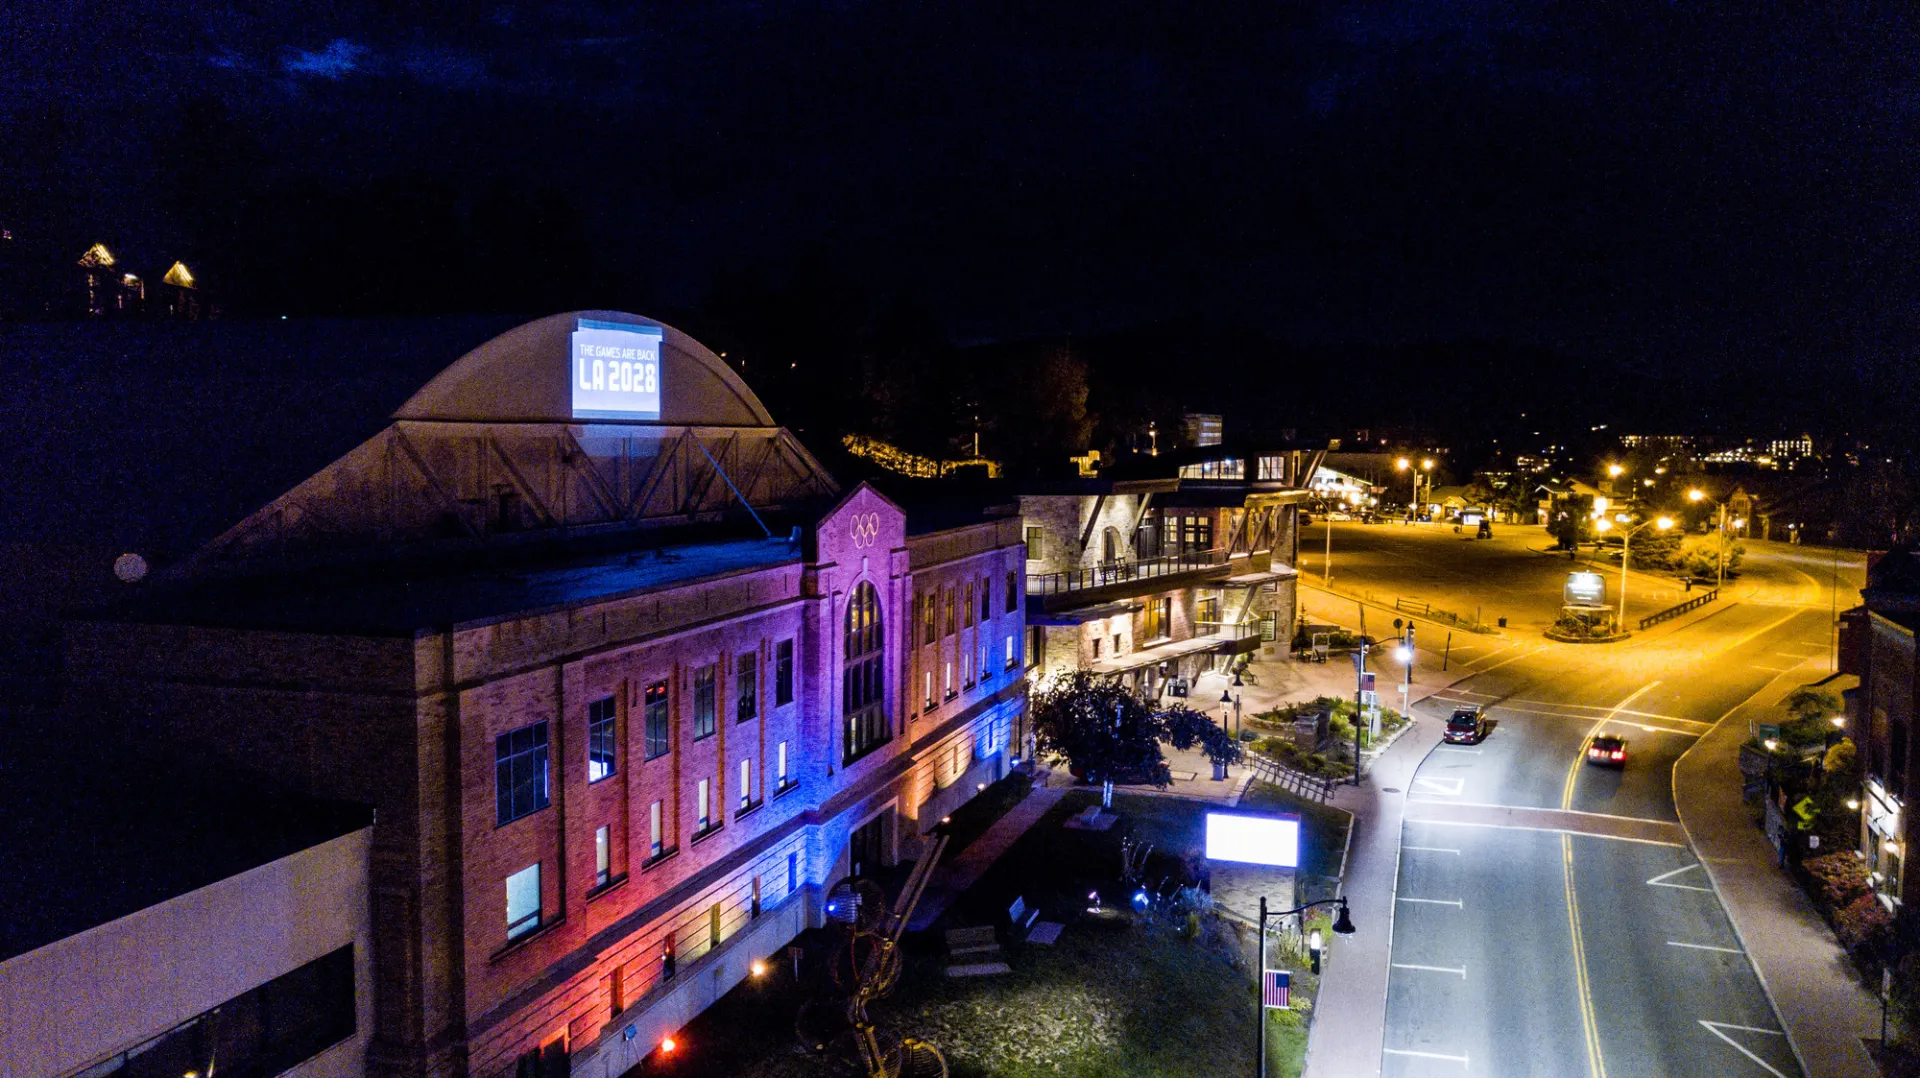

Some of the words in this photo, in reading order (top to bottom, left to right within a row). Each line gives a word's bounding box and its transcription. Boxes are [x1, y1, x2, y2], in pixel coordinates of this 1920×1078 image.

[580, 344, 594, 356] THE
[596, 345, 620, 358] GAMES
[622, 348, 635, 359] ARE
[638, 349, 655, 360] BACK
[580, 358, 604, 390] LA
[608, 361, 656, 392] 2028
